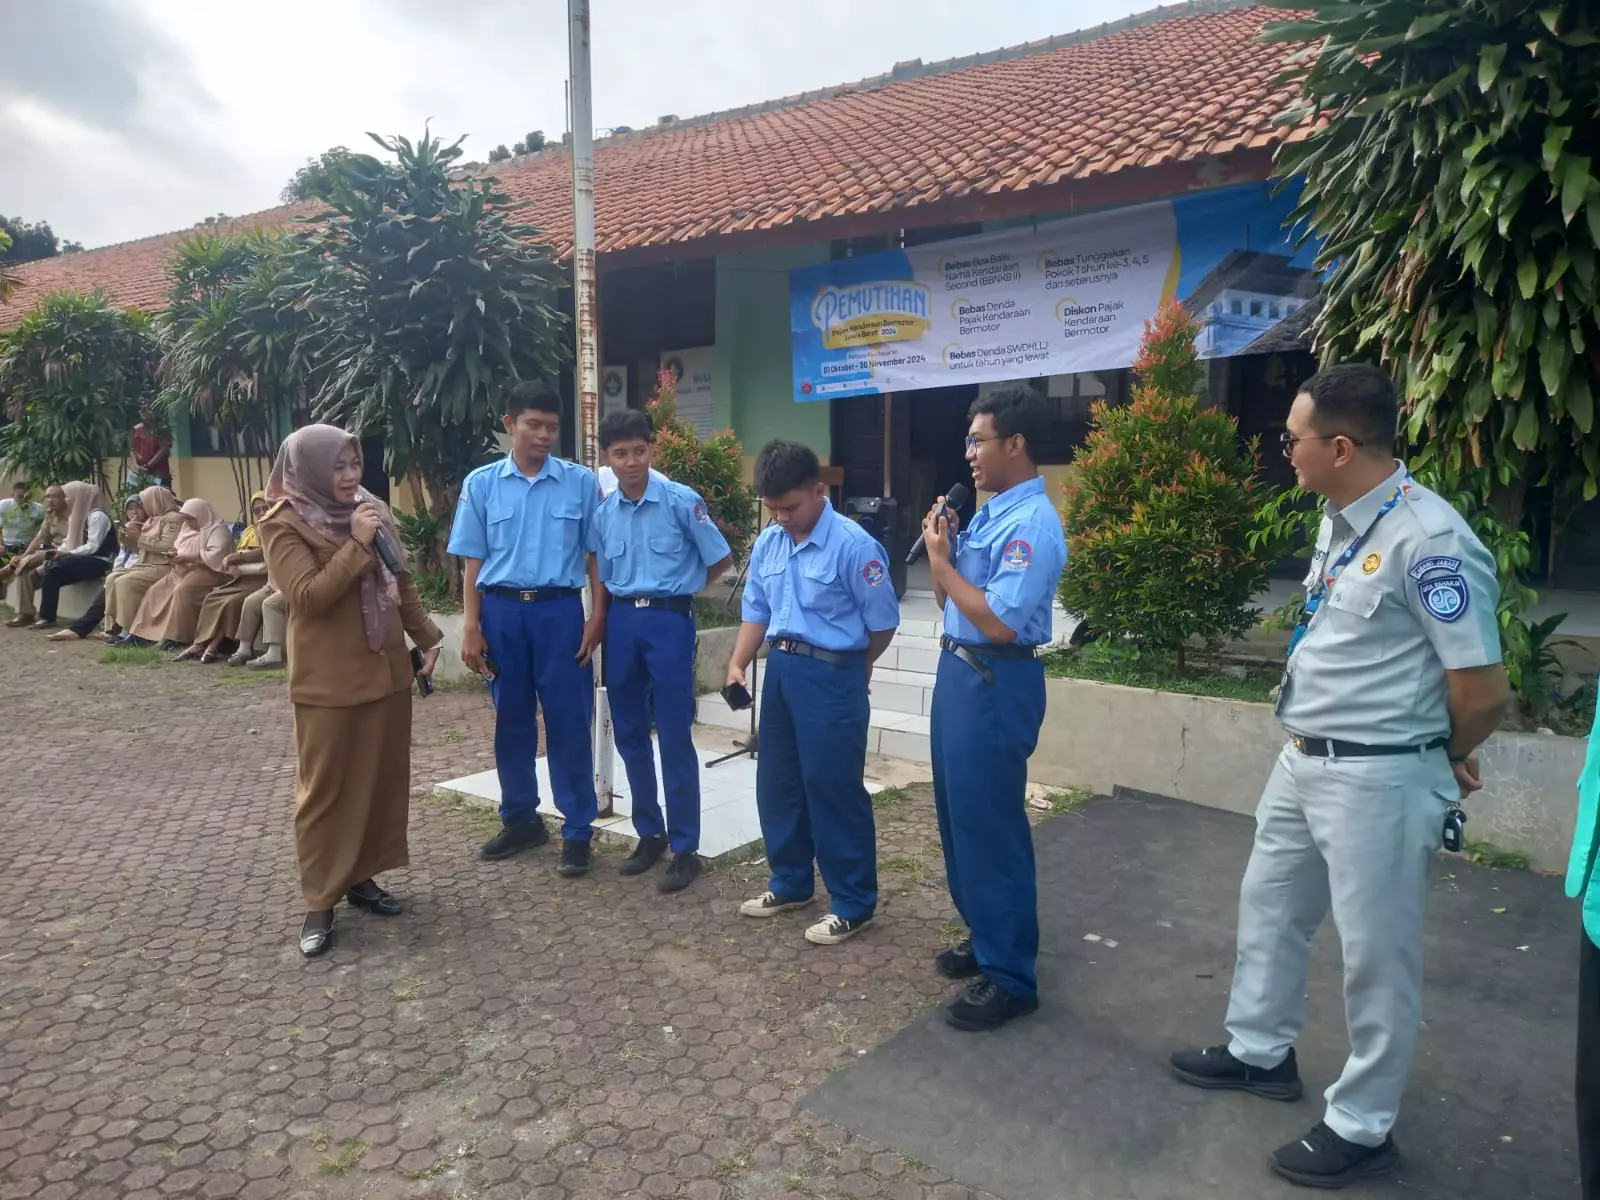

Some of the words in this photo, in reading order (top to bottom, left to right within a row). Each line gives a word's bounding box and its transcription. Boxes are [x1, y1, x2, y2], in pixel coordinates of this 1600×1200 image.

[1045, 258, 1074, 269] Bebas
[1076, 248, 1131, 263] Tunggakan
[1045, 267, 1074, 279] Pokok
[1076, 263, 1105, 274] Tahun
[1142, 253, 1149, 264] 5
[945, 271, 971, 281] Nama
[972, 262, 1019, 277] Kendaraan
[945, 279, 977, 291] Second
[1045, 280, 1063, 290] dan
[1065, 272, 1118, 287] seterusnya
[815, 284, 926, 342] PEMUTIHAN
[959, 304, 986, 315] Bebas
[986, 299, 1016, 311] Denda
[1064, 305, 1097, 317] Diskon
[1098, 300, 1124, 313] Pajak
[959, 315, 981, 327] Pajak
[982, 308, 1031, 322] Kendaraan
[1064, 313, 1116, 327] Kendaraan
[881, 328, 897, 336] 2024
[959, 323, 1001, 335] Bermotor
[1064, 325, 1111, 338] Bermotor
[949, 349, 976, 360] Bebas
[977, 346, 1006, 357] Denda
[949, 359, 974, 370] untuk
[975, 356, 1001, 367] tahun
[1002, 353, 1024, 367] yang
[1024, 351, 1050, 362] lewat
[830, 363, 855, 373] Oktober
[859, 361, 868, 369] 30
[868, 357, 905, 369] November
[906, 354, 926, 364] 2024
